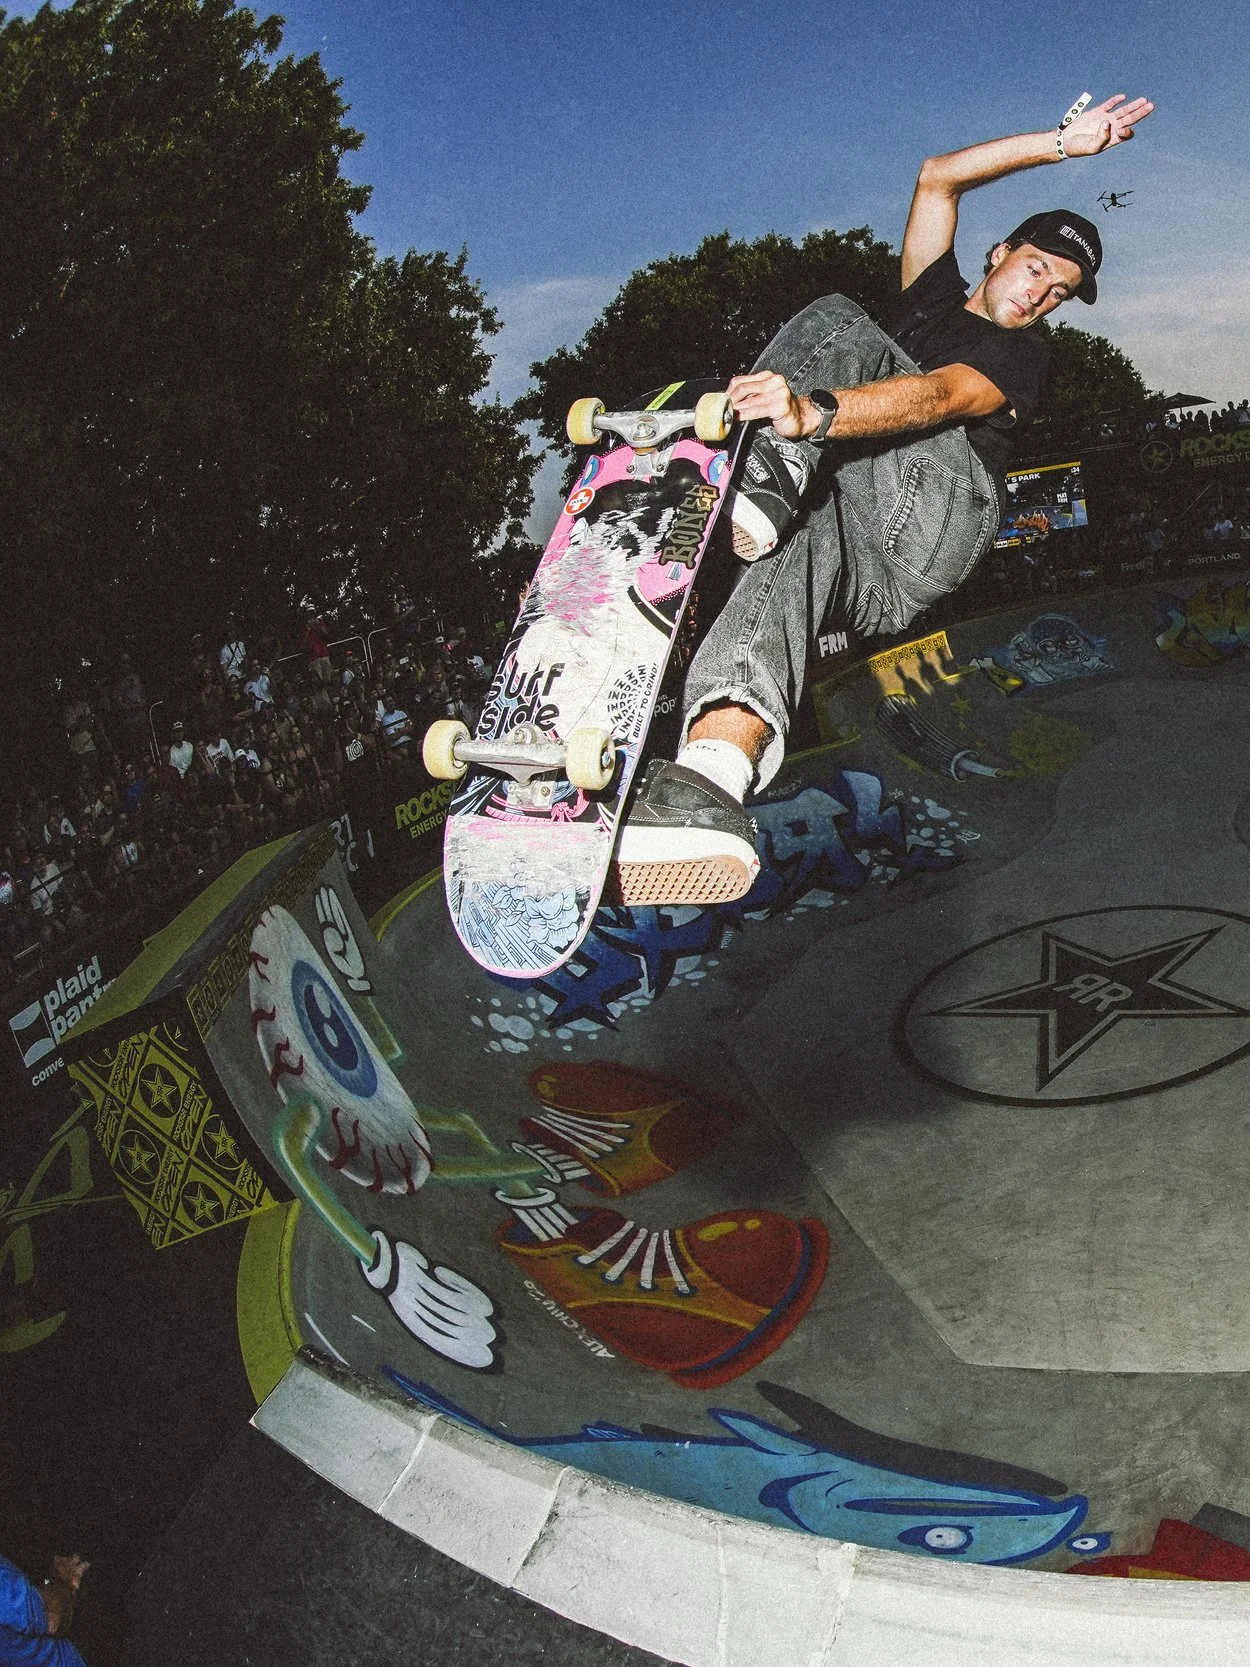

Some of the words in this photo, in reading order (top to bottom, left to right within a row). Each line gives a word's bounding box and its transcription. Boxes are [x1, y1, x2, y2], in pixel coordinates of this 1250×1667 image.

[1194, 452, 1242, 468] ENERGY
[1018, 472, 1040, 481] PARK
[659, 484, 720, 569] BONES
[1188, 552, 1241, 565] PORTLAND
[632, 711, 644, 738] BUILT
[640, 698, 649, 710] TO
[654, 697, 678, 718] POR
[43, 955, 103, 1020] plaid
[50, 978, 116, 1045] pant
[183, 1080, 198, 1108] ENERGY
[573, 1328, 615, 1358] ALEX
